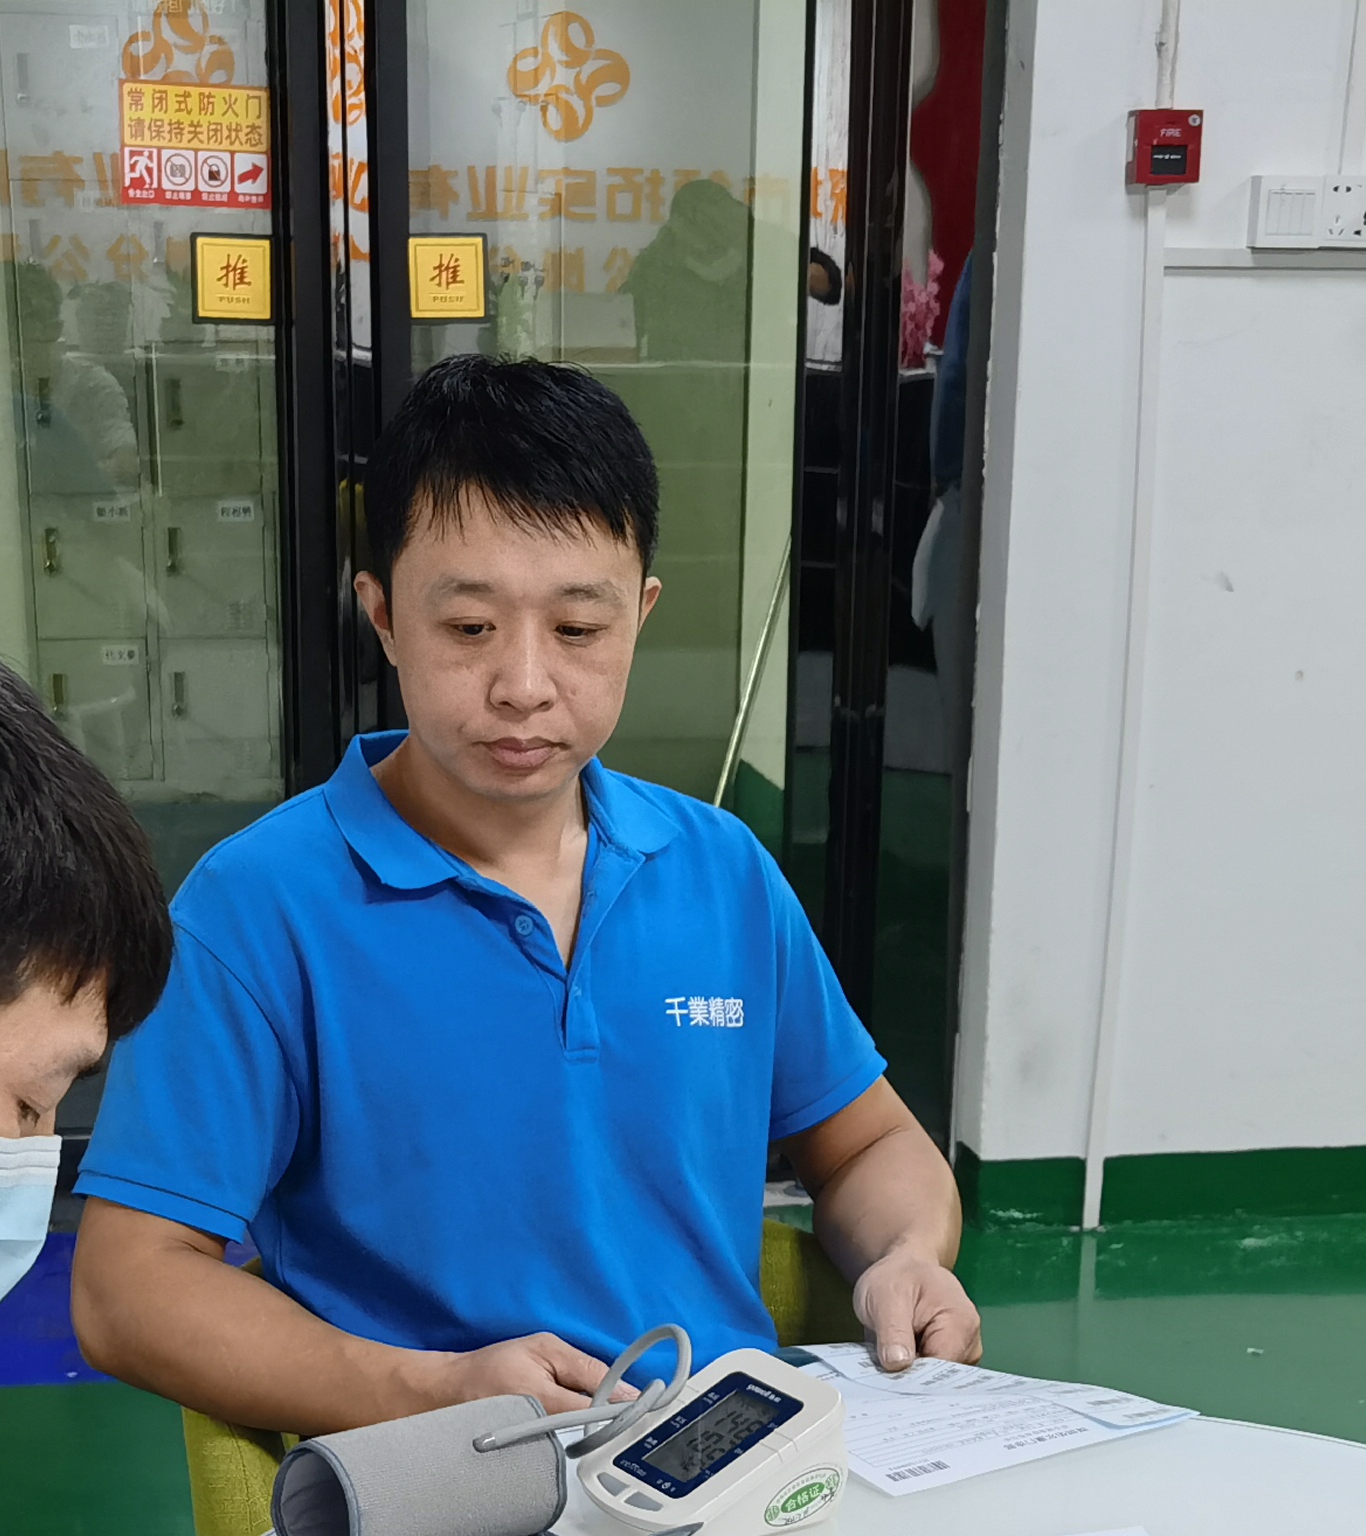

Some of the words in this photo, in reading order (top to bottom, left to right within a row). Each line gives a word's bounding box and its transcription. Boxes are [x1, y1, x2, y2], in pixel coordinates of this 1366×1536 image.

[128, 88, 262, 120] 常闭式防火门
[128, 116, 264, 147] 请保持关闭状态
[1160, 128, 1182, 137] FIRE
[216, 253, 252, 290] 推
[429, 253, 464, 290] 推
[218, 296, 250, 304] PUSH
[785, 1483, 825, 1513] 合格证
